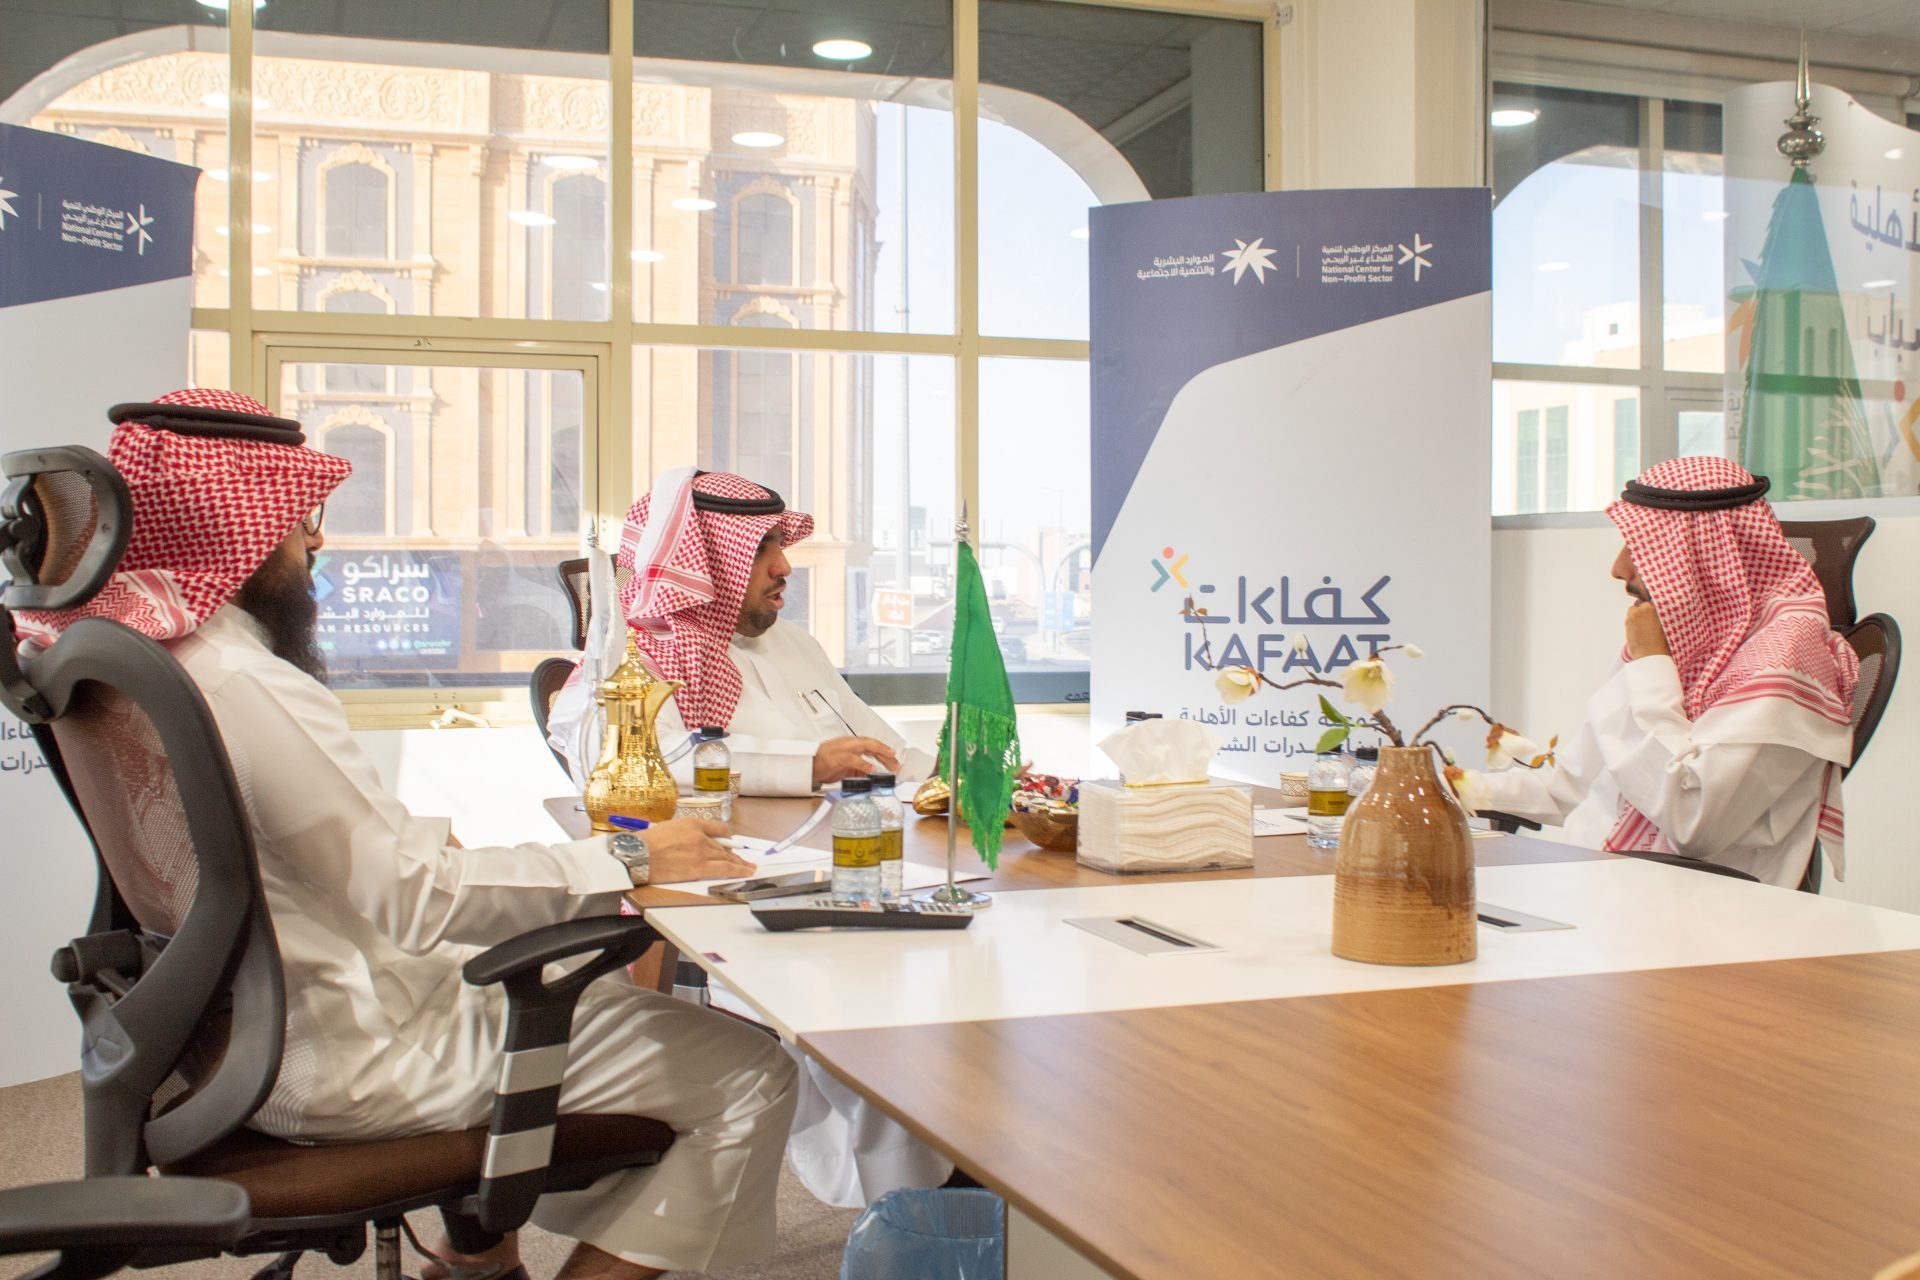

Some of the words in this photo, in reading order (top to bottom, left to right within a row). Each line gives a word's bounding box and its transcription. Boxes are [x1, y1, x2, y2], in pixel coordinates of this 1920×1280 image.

[1851, 179, 1920, 253] أهلية
[62, 221, 91, 235] National
[102, 240, 123, 251] Sector
[1344, 244, 1371, 254] الوطني
[1372, 244, 1394, 254] المركز
[1153, 255, 1184, 268] البشرية
[1185, 253, 1215, 266] الموارد
[1349, 255, 1365, 264] غير
[1366, 254, 1394, 264] القطاع
[1136, 267, 1179, 280] الاجتماعية
[1179, 265, 1215, 278] والتنمية
[1322, 265, 1354, 273] National
[1355, 265, 1381, 273] Center
[1381, 264, 1393, 273] for
[1367, 274, 1393, 282] Sector
[342, 555, 430, 585] سراكو
[342, 586, 430, 603] SRACO
[317, 606, 359, 621] البش
[363, 606, 430, 622] للموارد
[344, 623, 430, 633] RESOURCES
[1185, 632, 1391, 674] KAFAAT
[1245, 708, 1310, 727] كفاءات
[1264, 736, 1318, 757] درات
[1, 751, 49, 774] درات
